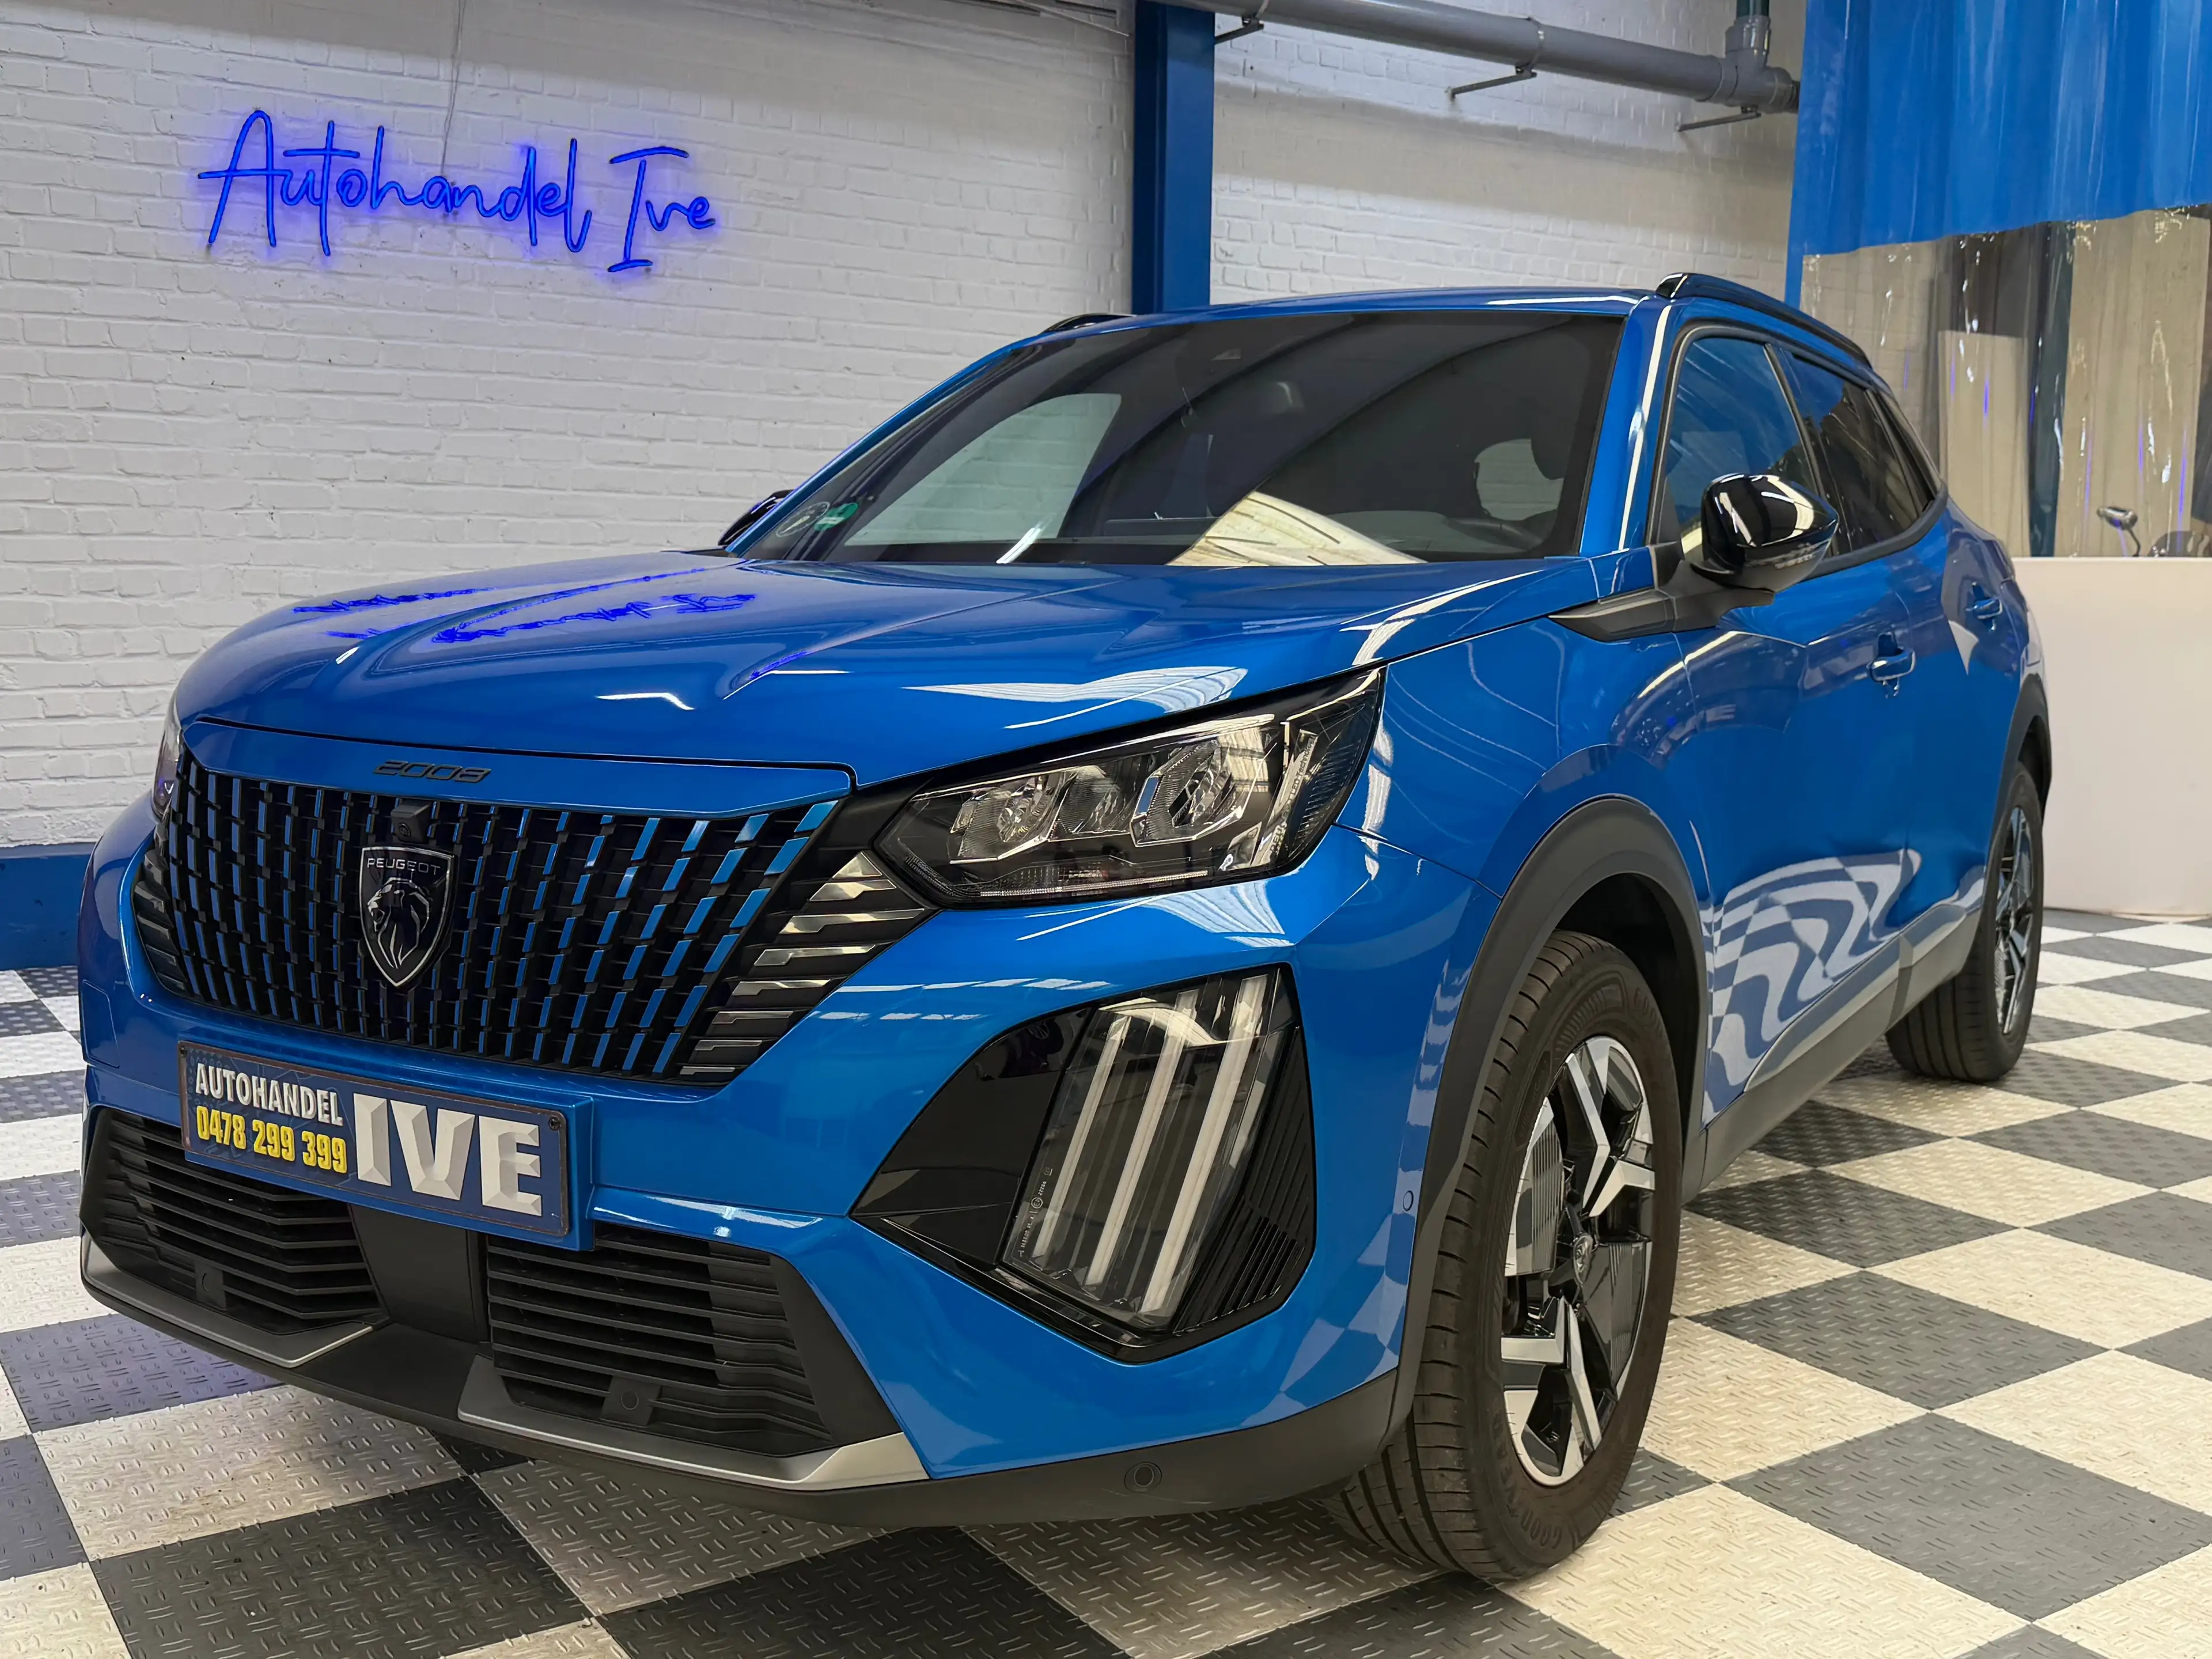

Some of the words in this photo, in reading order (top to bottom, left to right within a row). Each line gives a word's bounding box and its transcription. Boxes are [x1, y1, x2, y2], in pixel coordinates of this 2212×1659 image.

[198, 110, 592, 257] Autohandel
[608, 146, 716, 272] Ive
[373, 759, 491, 783] 2008
[367, 857, 441, 876] PEUGEOT
[195, 1063, 343, 1126] AUTOHANDEL
[196, 1105, 247, 1150] 0478
[252, 1119, 296, 1162] 299
[301, 1131, 348, 1174] 399
[353, 1093, 542, 1217] IVE
